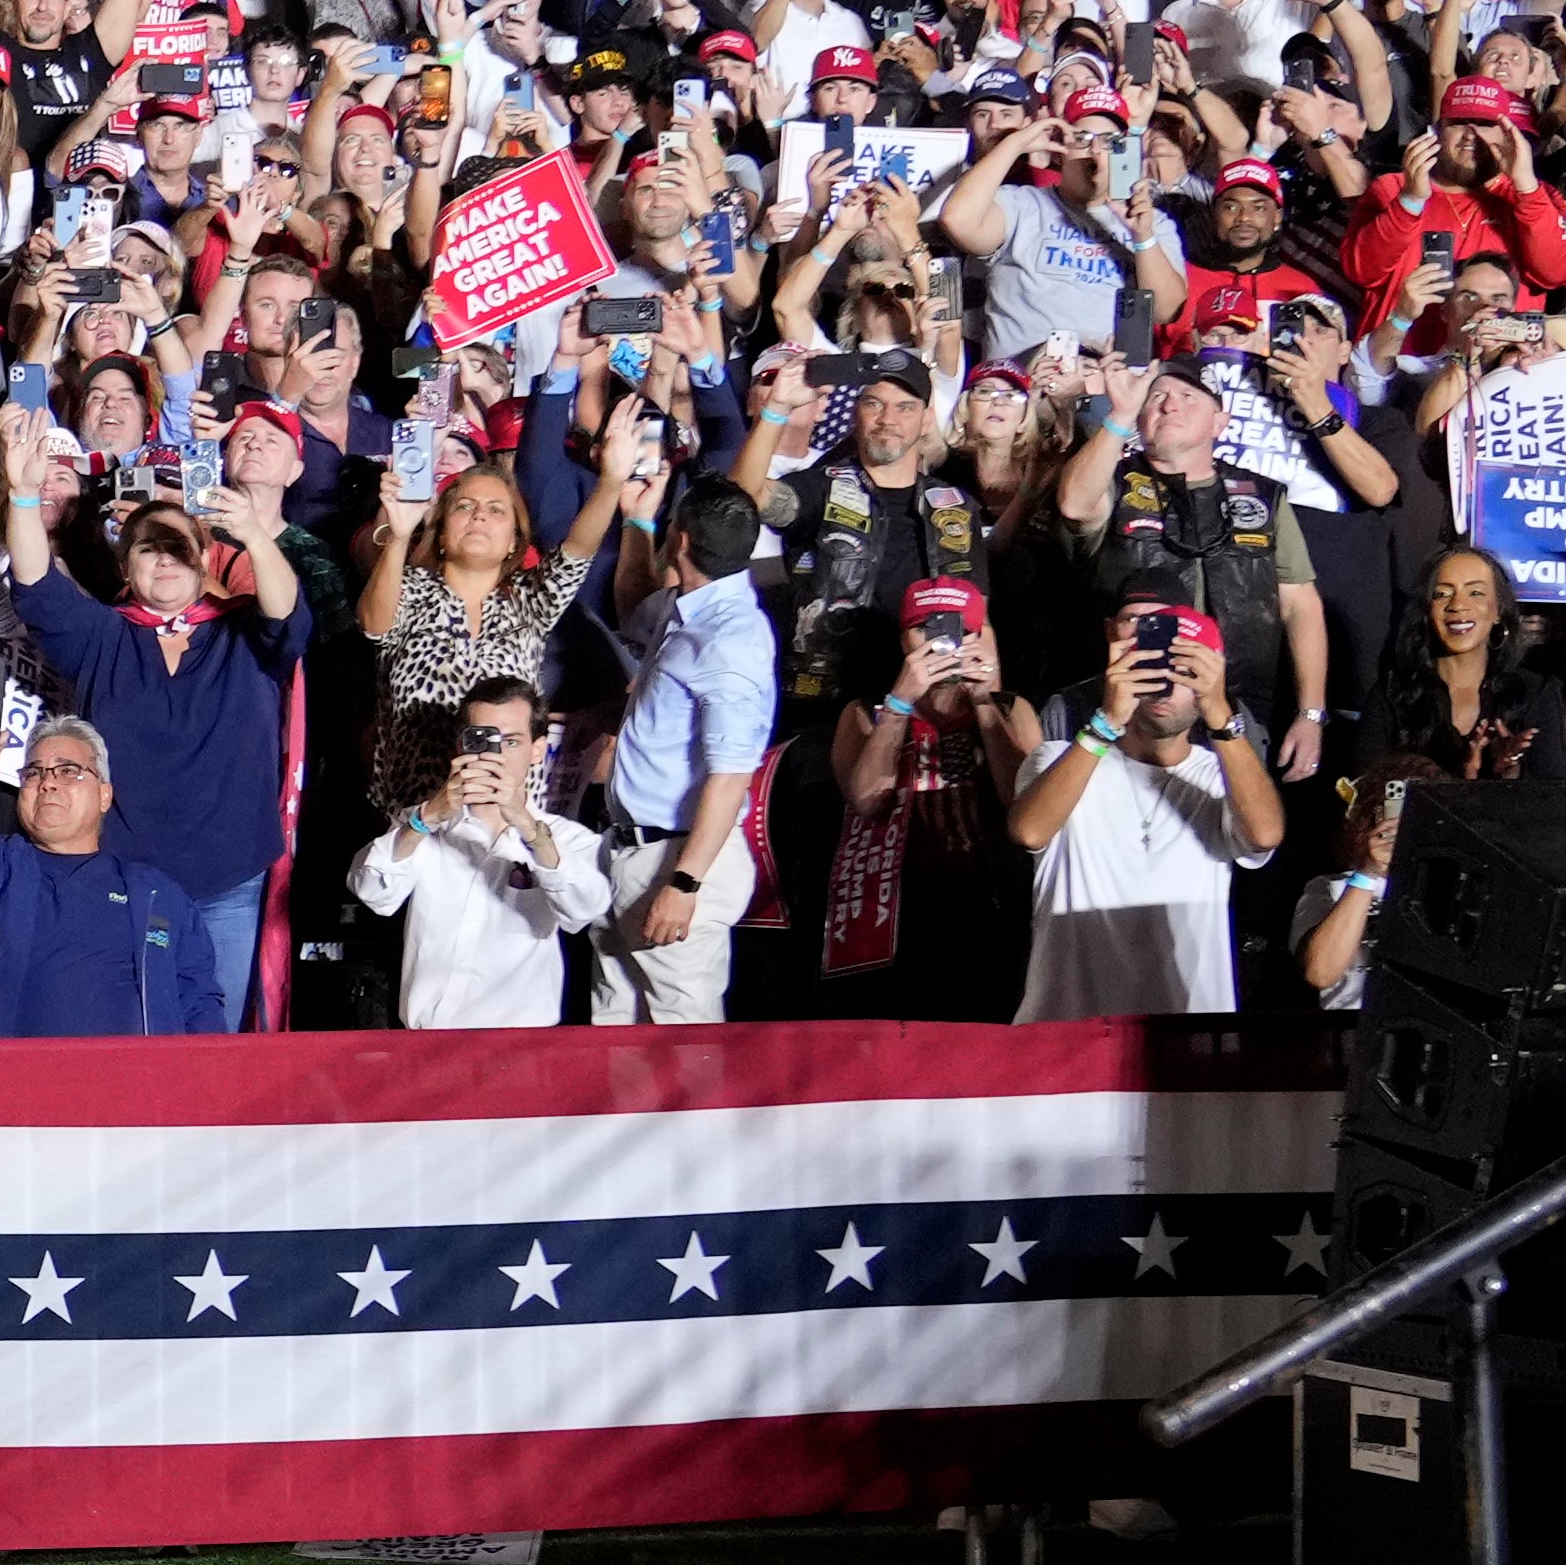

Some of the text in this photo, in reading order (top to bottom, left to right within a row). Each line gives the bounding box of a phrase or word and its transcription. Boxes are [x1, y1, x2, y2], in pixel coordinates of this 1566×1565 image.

[208, 66, 250, 87] MAK
[1454, 84, 1500, 99] TRUMP
[858, 143, 916, 164] AKE
[432, 200, 563, 281] AMERICA
[444, 184, 528, 246] MAKE
[452, 230, 551, 294] GREAT
[465, 252, 570, 321] AGAIN!
[1045, 245, 1120, 279] TRUM
[1210, 288, 1243, 311] 47
[1218, 418, 1308, 456] REAT
[1490, 385, 1512, 458] RICA
[1517, 401, 1541, 461] EAT
[1543, 394, 1566, 462] AIN!
[1213, 445, 1308, 483] GAIN!
[850, 829, 874, 920] RUMP
